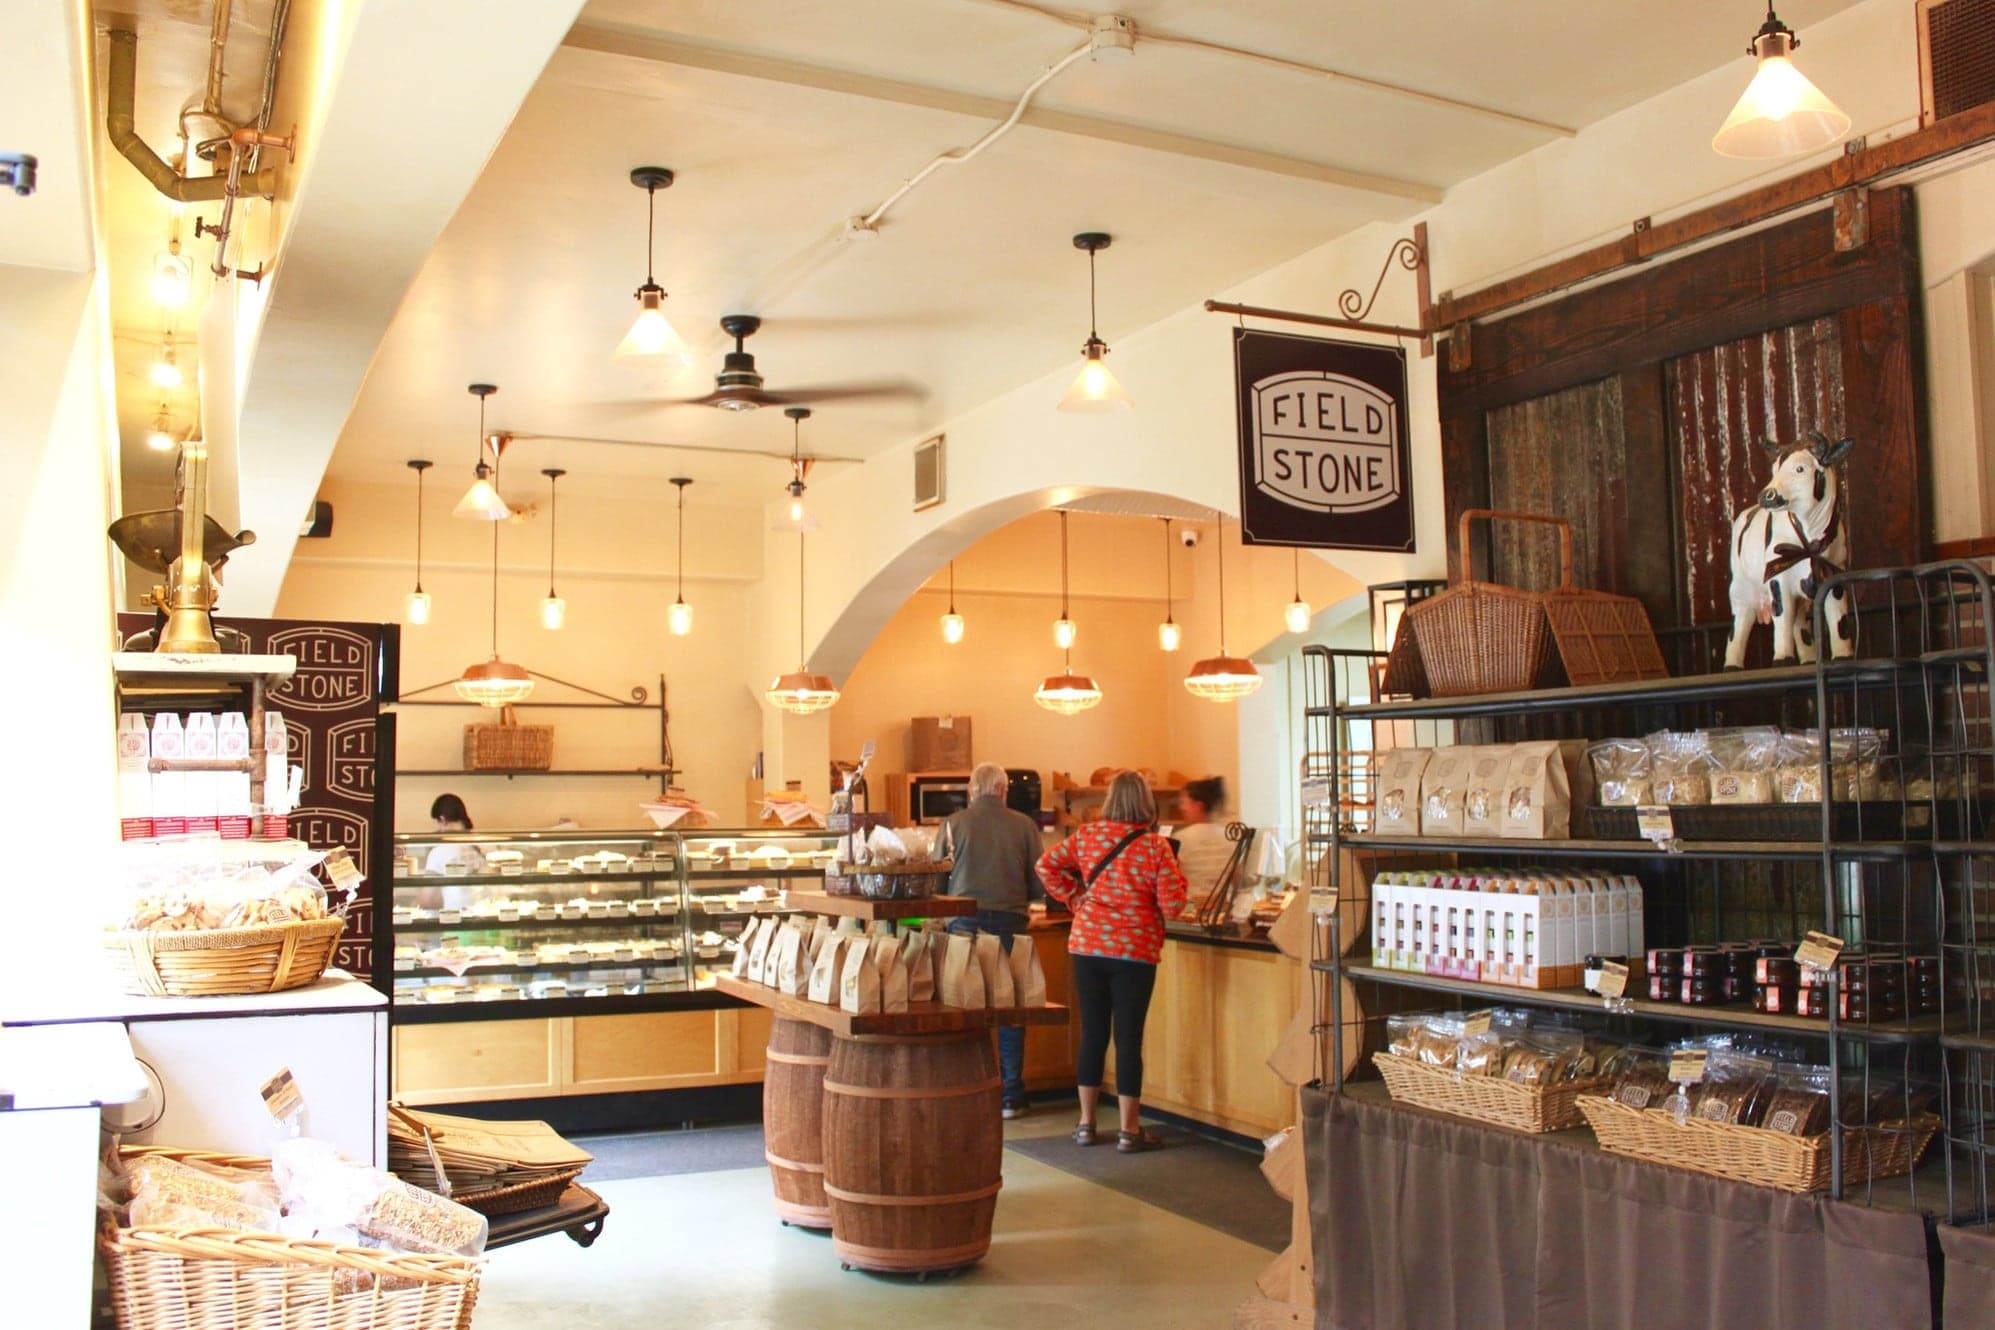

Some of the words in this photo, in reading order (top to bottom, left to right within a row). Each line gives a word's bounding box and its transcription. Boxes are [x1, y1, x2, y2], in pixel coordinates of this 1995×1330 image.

[1273, 392, 1384, 435] FIELD
[1273, 449, 1384, 494] STONE
[287, 820, 357, 844] IELD
